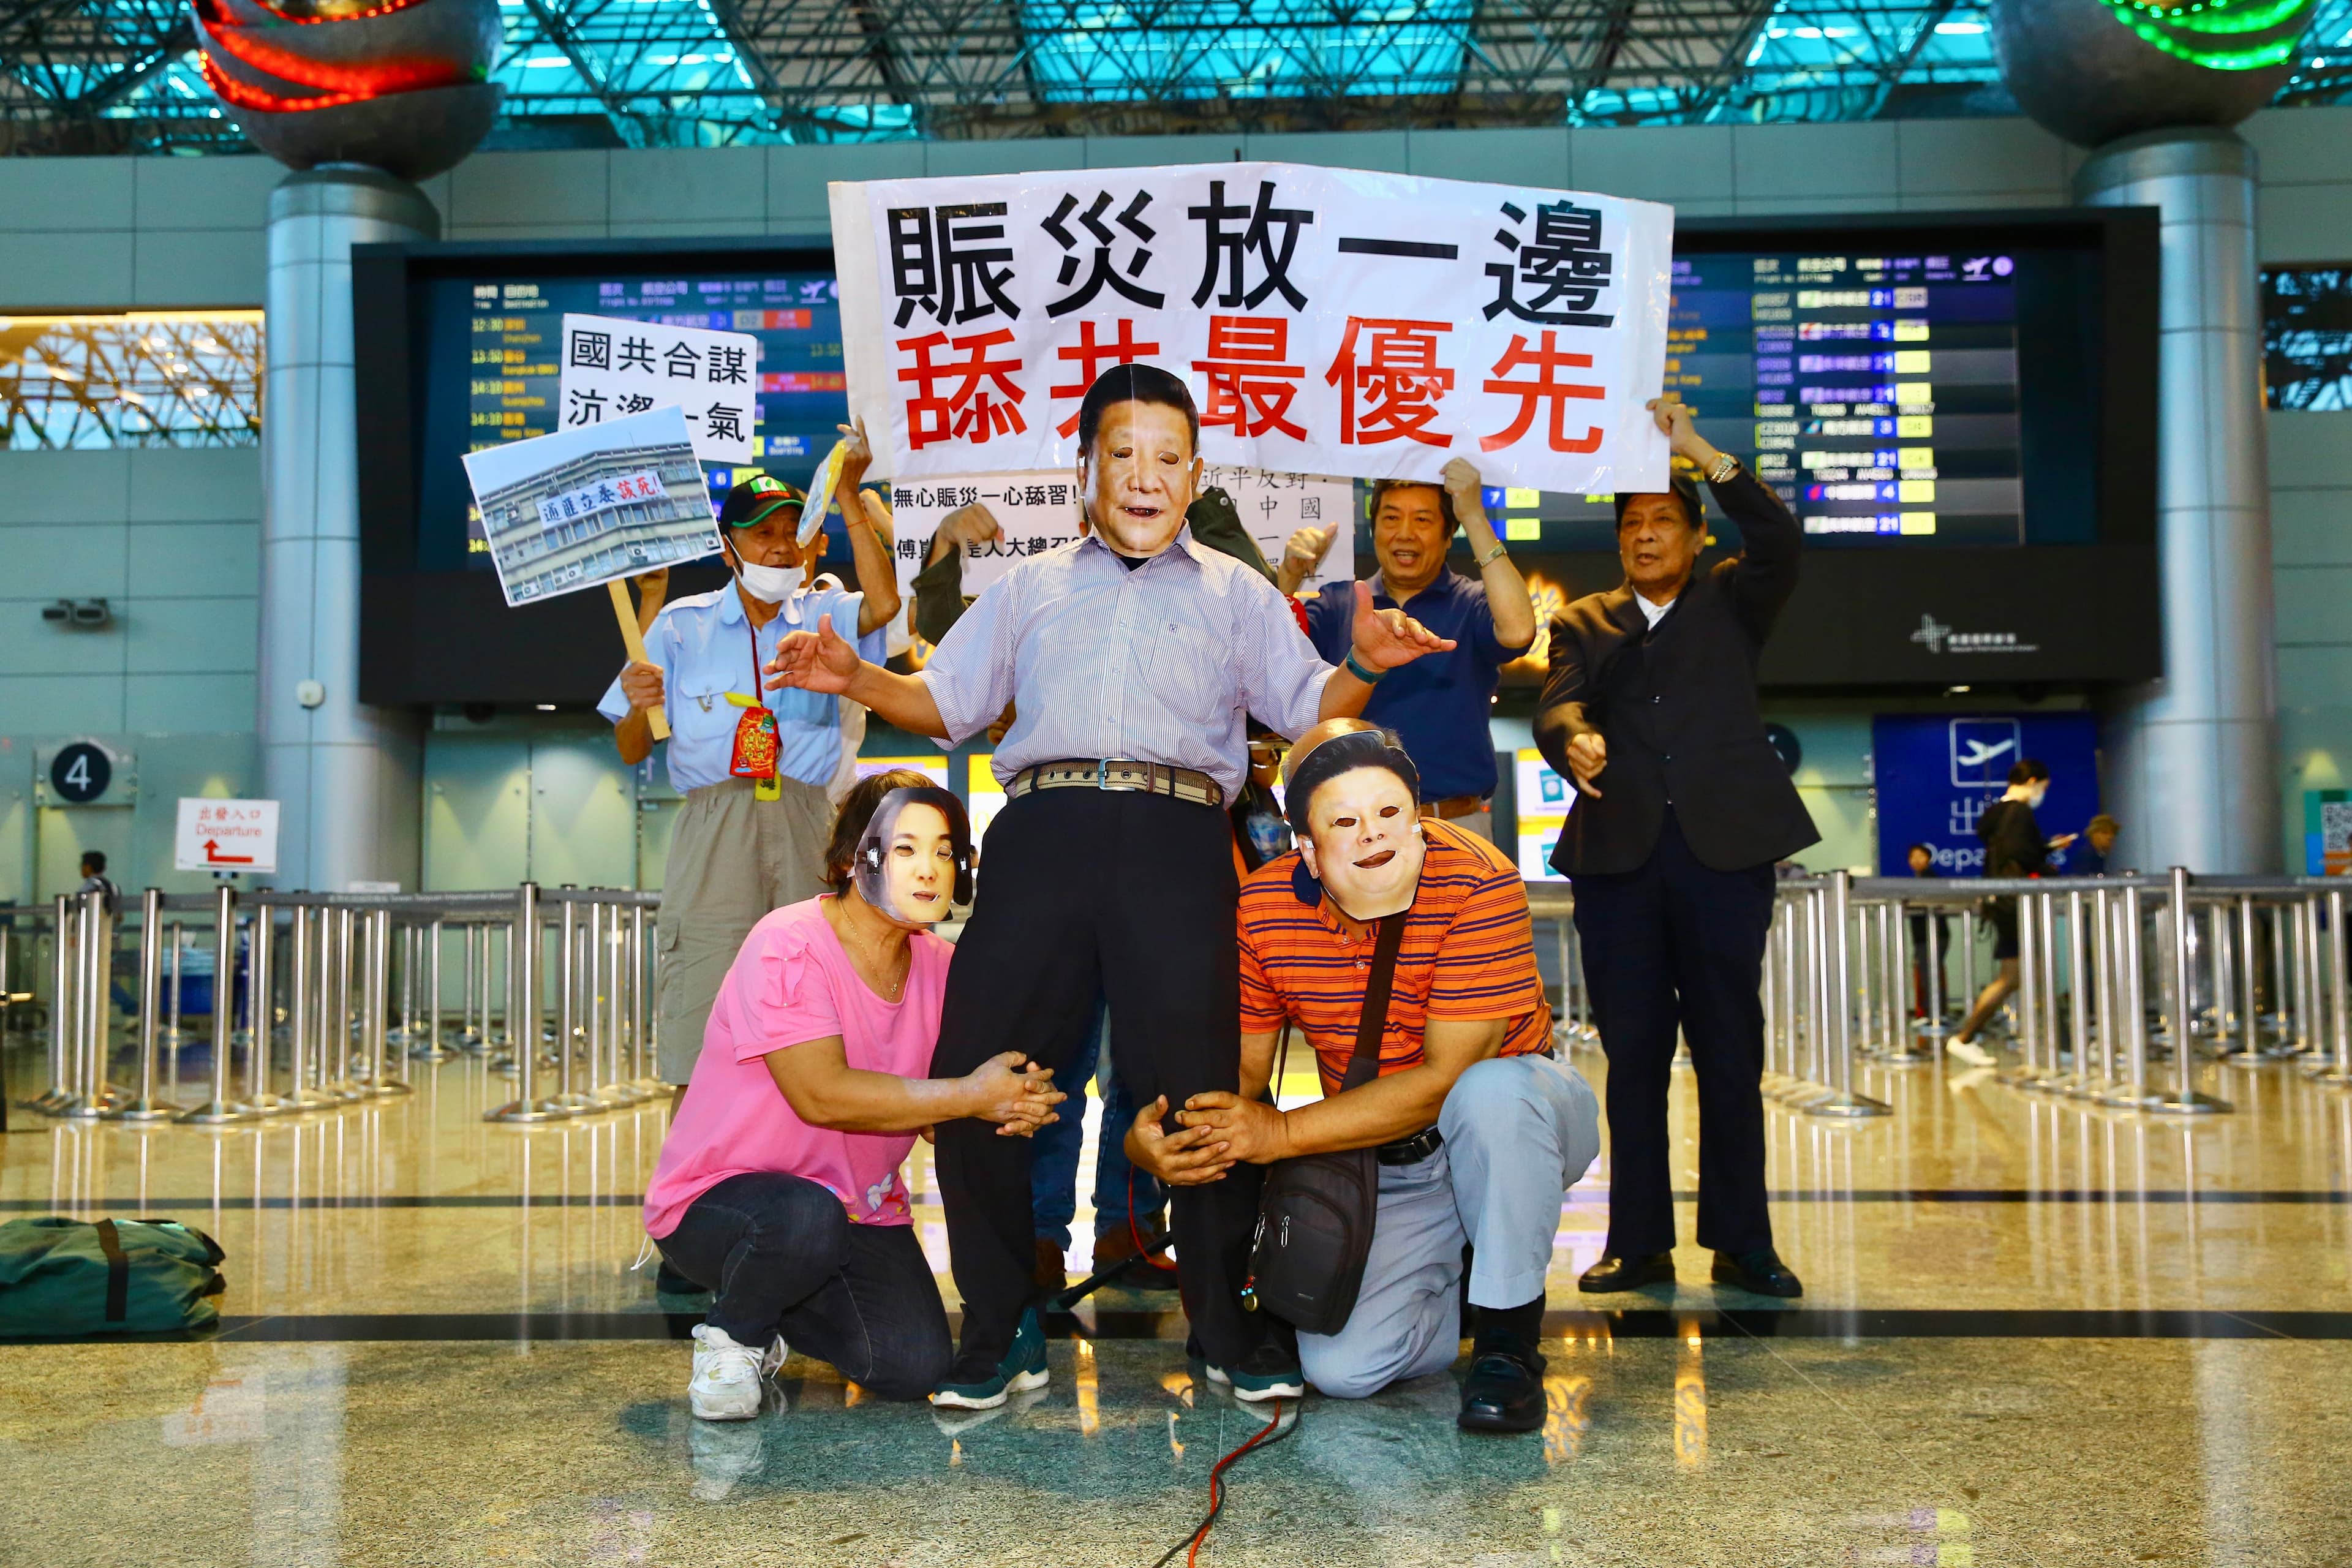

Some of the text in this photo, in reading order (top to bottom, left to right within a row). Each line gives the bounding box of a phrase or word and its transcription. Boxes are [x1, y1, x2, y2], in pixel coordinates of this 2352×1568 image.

[888, 181, 1615, 328] 賑災放一邊
[571, 330, 747, 384] 國共合謀
[896, 315, 1605, 453] 舔共最優先
[894, 485, 1077, 508] 無心賑災一心舔習!
[65, 755, 92, 791] 4
[195, 823, 262, 839] Departure
[199, 806, 261, 821] 出發入口
